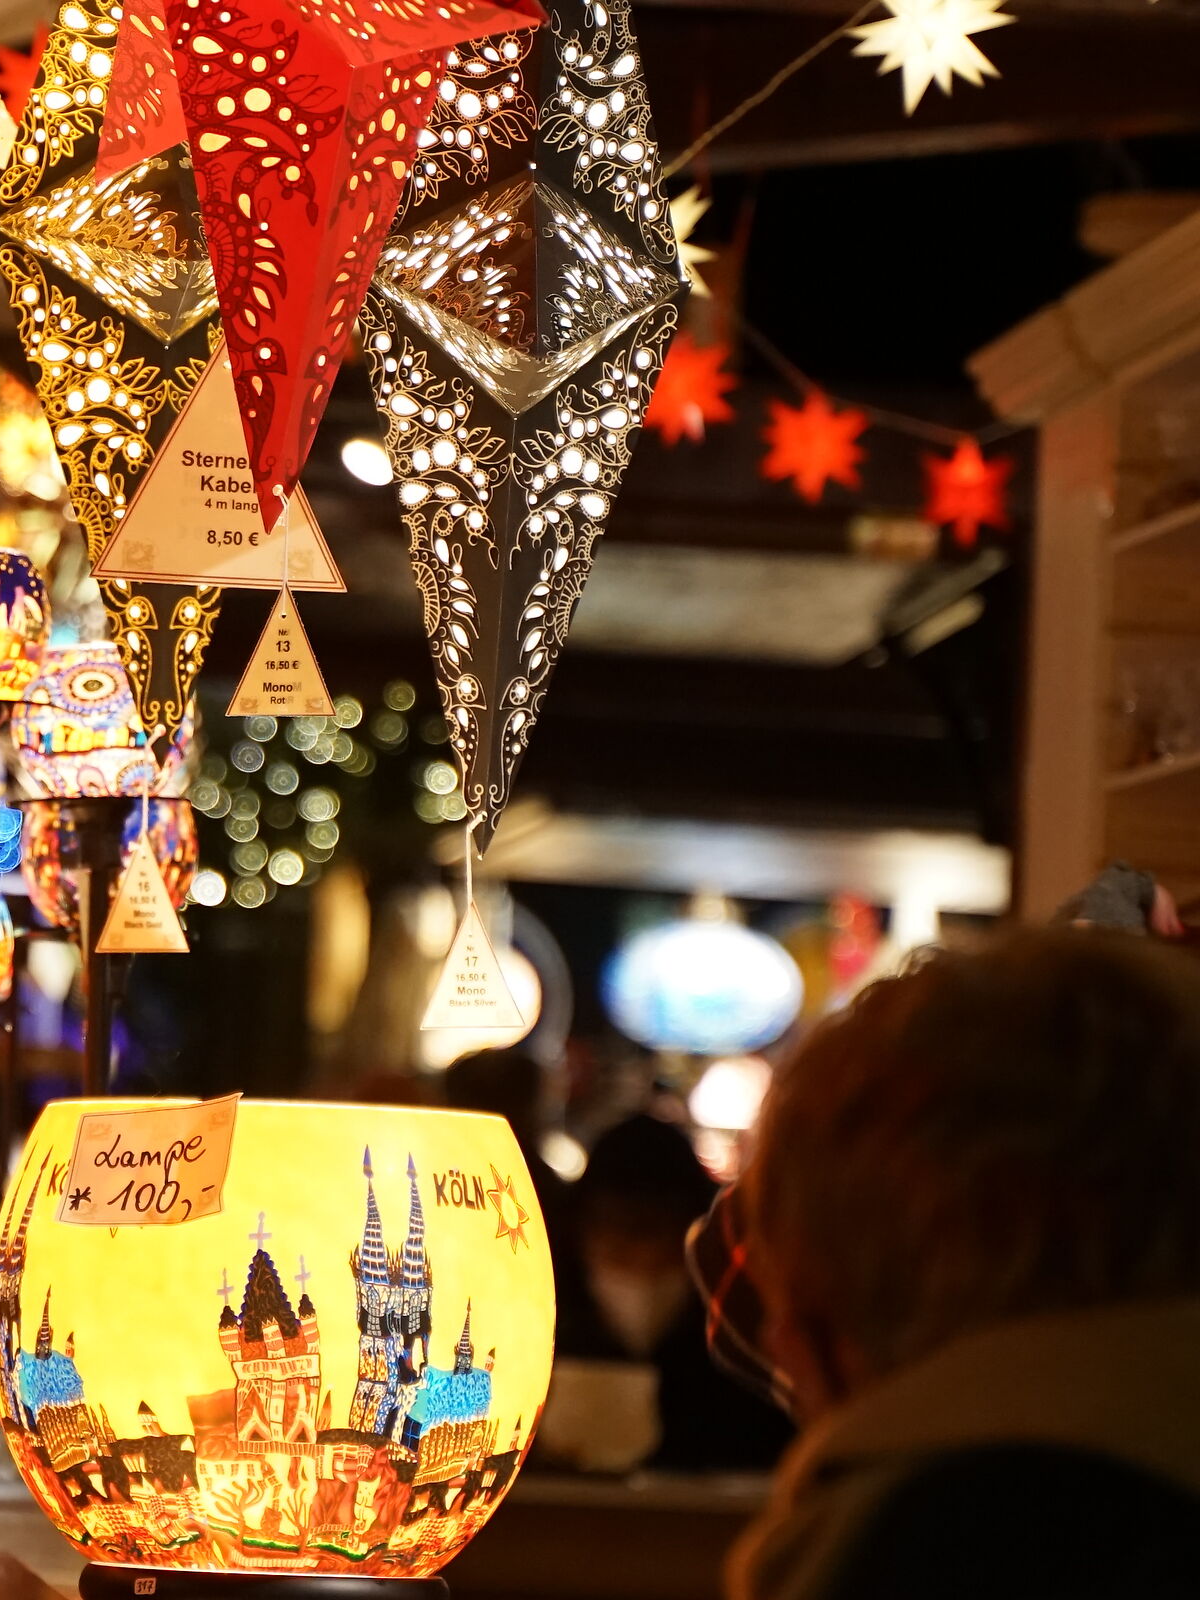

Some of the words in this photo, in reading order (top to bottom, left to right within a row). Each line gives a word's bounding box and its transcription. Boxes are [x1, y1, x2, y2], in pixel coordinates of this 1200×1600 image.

[181, 450, 252, 470] Sterne
[204, 498, 212, 508] 4
[216, 500, 227, 509] m
[232, 499, 259, 513] lang
[207, 530, 243, 547] 8,50
[248, 532, 259, 546] €
[276, 640, 290, 652] 13
[262, 682, 293, 692] Mono
[270, 696, 285, 705] Rot
[465, 956, 478, 967] 17
[457, 986, 486, 995] Mono
[94, 1134, 207, 1187] Lampe
[433, 1169, 486, 1210] KÖLN
